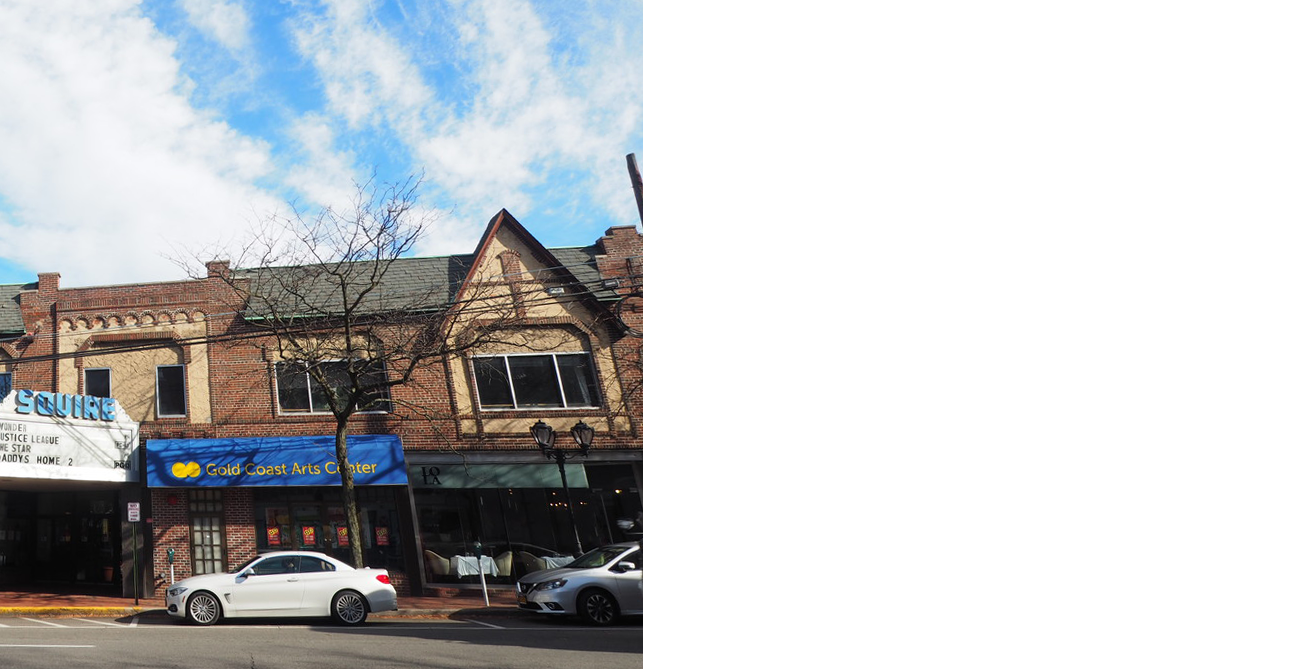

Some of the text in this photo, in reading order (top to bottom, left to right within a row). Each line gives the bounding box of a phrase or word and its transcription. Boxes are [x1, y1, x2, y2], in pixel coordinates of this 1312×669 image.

[15, 389, 116, 421] SQUIRE
[31, 435, 59, 445] LEAGUE
[12, 444, 31, 453] STAR
[37, 456, 60, 465] HOME
[68, 458, 73, 466] 2
[206, 463, 240, 475] Gold
[245, 463, 287, 475] Coast
[291, 462, 321, 475] Arts
